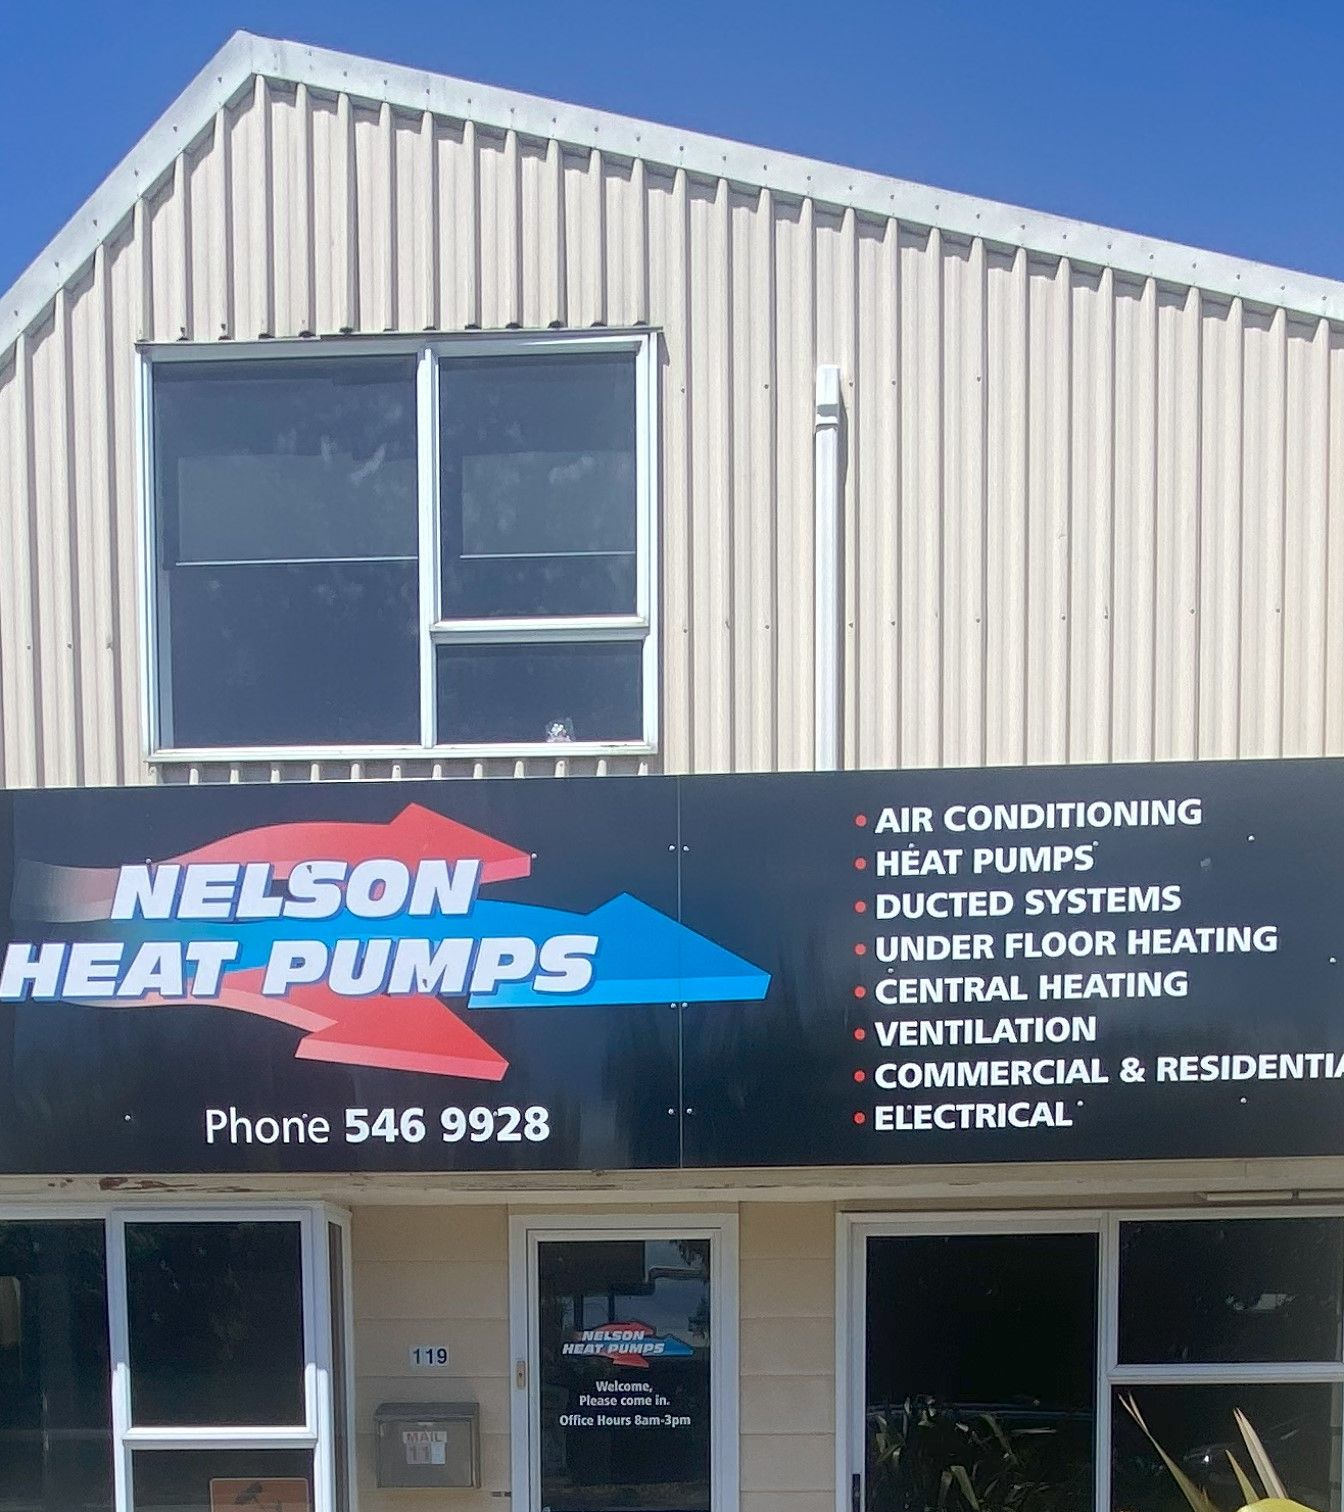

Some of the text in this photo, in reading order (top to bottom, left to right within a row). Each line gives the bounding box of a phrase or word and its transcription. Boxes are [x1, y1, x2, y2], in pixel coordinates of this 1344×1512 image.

[875, 799, 1201, 833] AIR CONDITIONING
[876, 845, 1093, 877] HEAT PUMPS
[110, 859, 480, 919] NELSON
[877, 886, 1181, 919] DUCTED SYSTEMS
[877, 926, 1277, 962] UNDER FLOOR HEATING
[264, 935, 599, 995] PUMPS
[875, 971, 1187, 1004] CENTRAL HEATING
[875, 1017, 1096, 1046] VENTILATION
[875, 1059, 1108, 1088] COMMERCIAL
[1120, 1057, 1145, 1082] &
[206, 1107, 549, 1143] Phone 546 9928
[876, 1102, 1072, 1130] ELECTRICAL
[562, 1343, 665, 1355] HEAT PUMPS
[582, 1331, 645, 1341] NELSON
[413, 1348, 448, 1364] 119
[579, 1394, 670, 1406] Please come in.
[596, 1380, 653, 1393] Welcome,
[559, 1415, 691, 1428] Office Hours 8am-3pm
